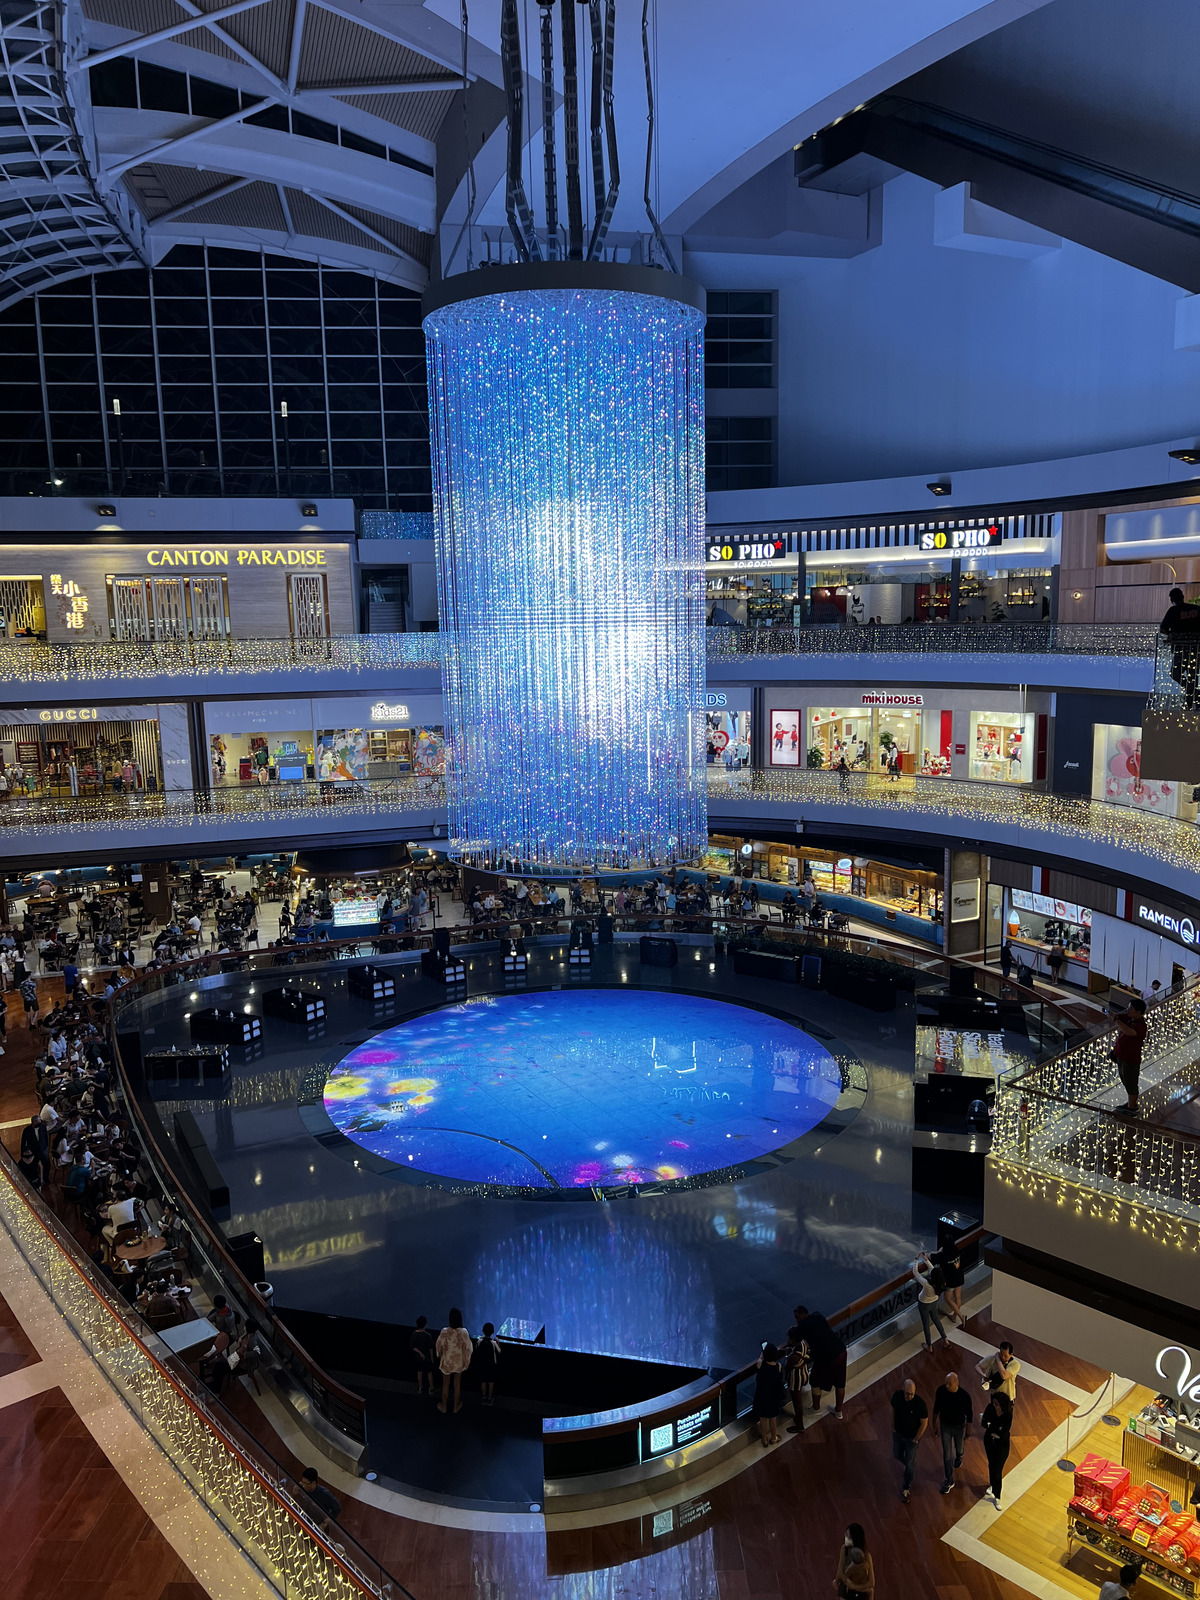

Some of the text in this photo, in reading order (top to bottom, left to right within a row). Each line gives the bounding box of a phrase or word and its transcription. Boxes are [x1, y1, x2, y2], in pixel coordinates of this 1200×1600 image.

[922, 529, 991, 549] SO PHO
[147, 549, 327, 566] CANTON PARADISE
[709, 543, 775, 560] SO PHO
[961, 548, 988, 556] GOOD
[63, 580, 88, 629] 小香港
[39, 708, 97, 721] GUCCI
[371, 705, 409, 717] kids21
[1139, 905, 1180, 934] RAMEN
[861, 1287, 913, 1330] CANVAS
